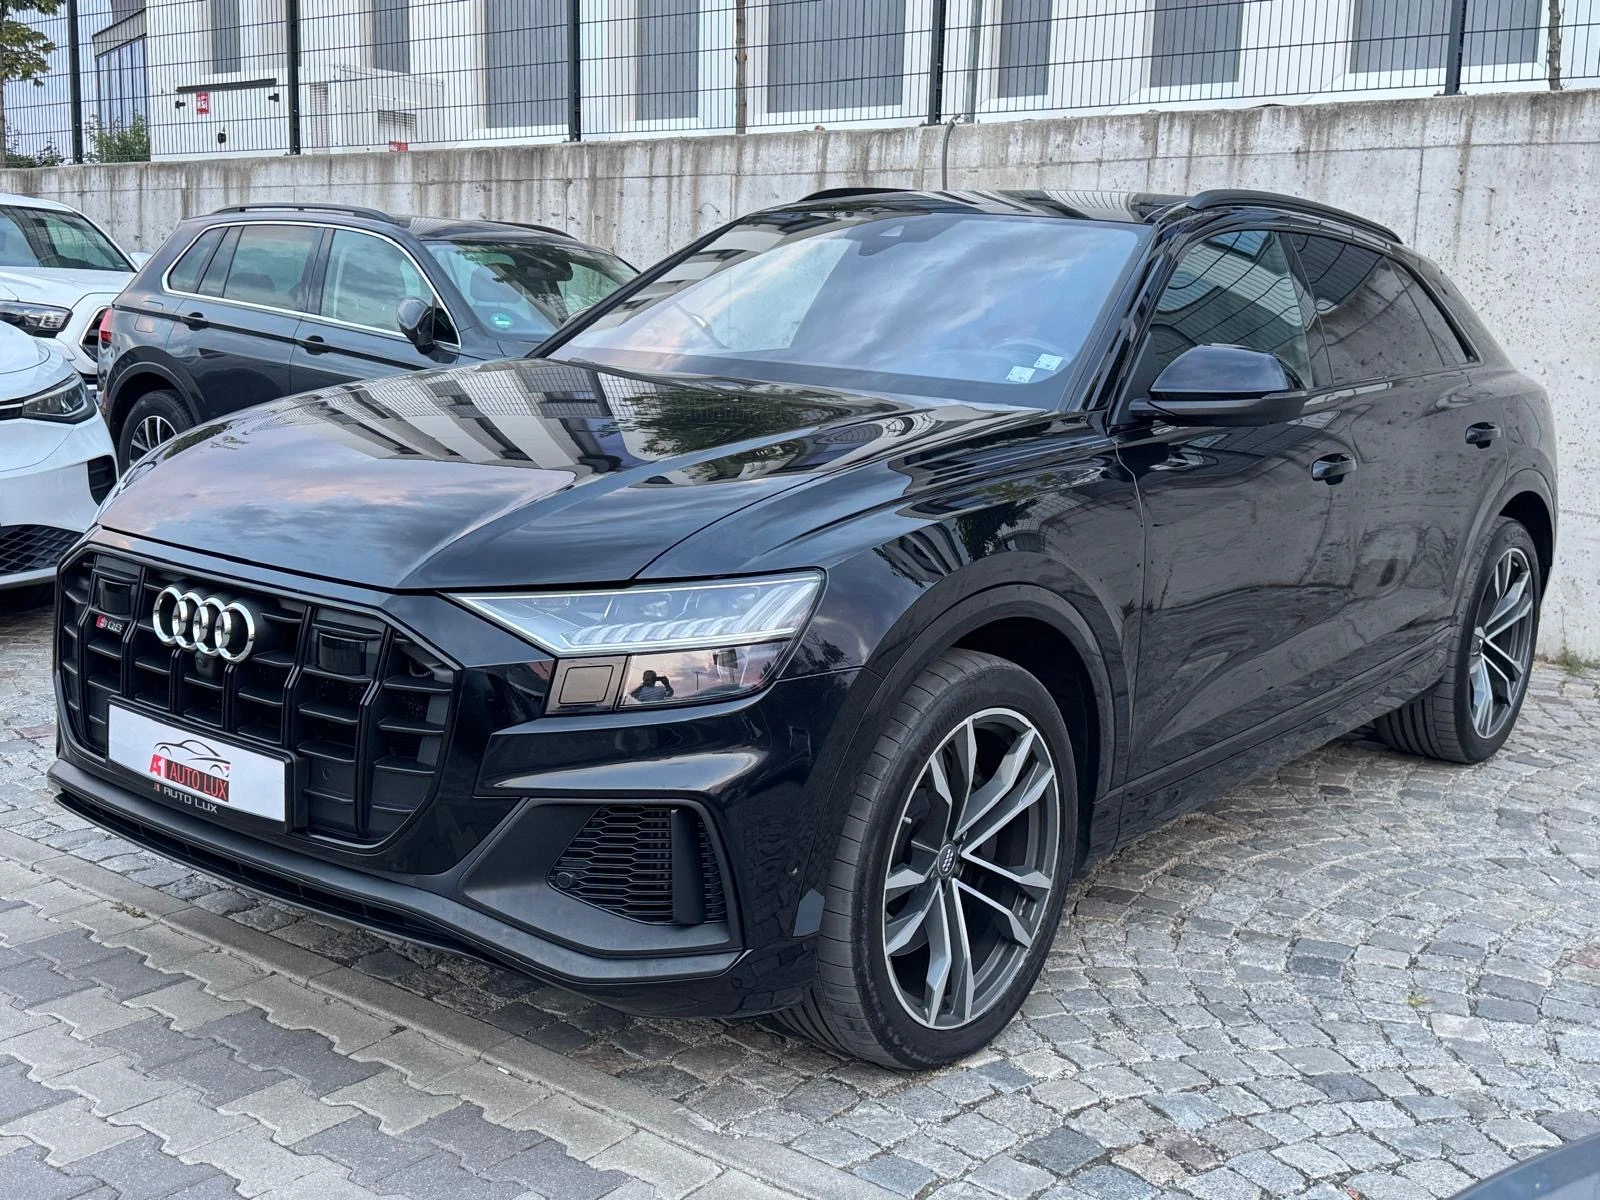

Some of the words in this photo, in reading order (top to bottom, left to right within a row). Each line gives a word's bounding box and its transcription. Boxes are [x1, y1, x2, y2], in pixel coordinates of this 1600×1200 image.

[150, 754, 167, 779] A1
[169, 762, 200, 790] AUTO
[203, 774, 228, 801] LUX
[163, 786, 192, 805] AUTO
[194, 797, 218, 814] LUX
